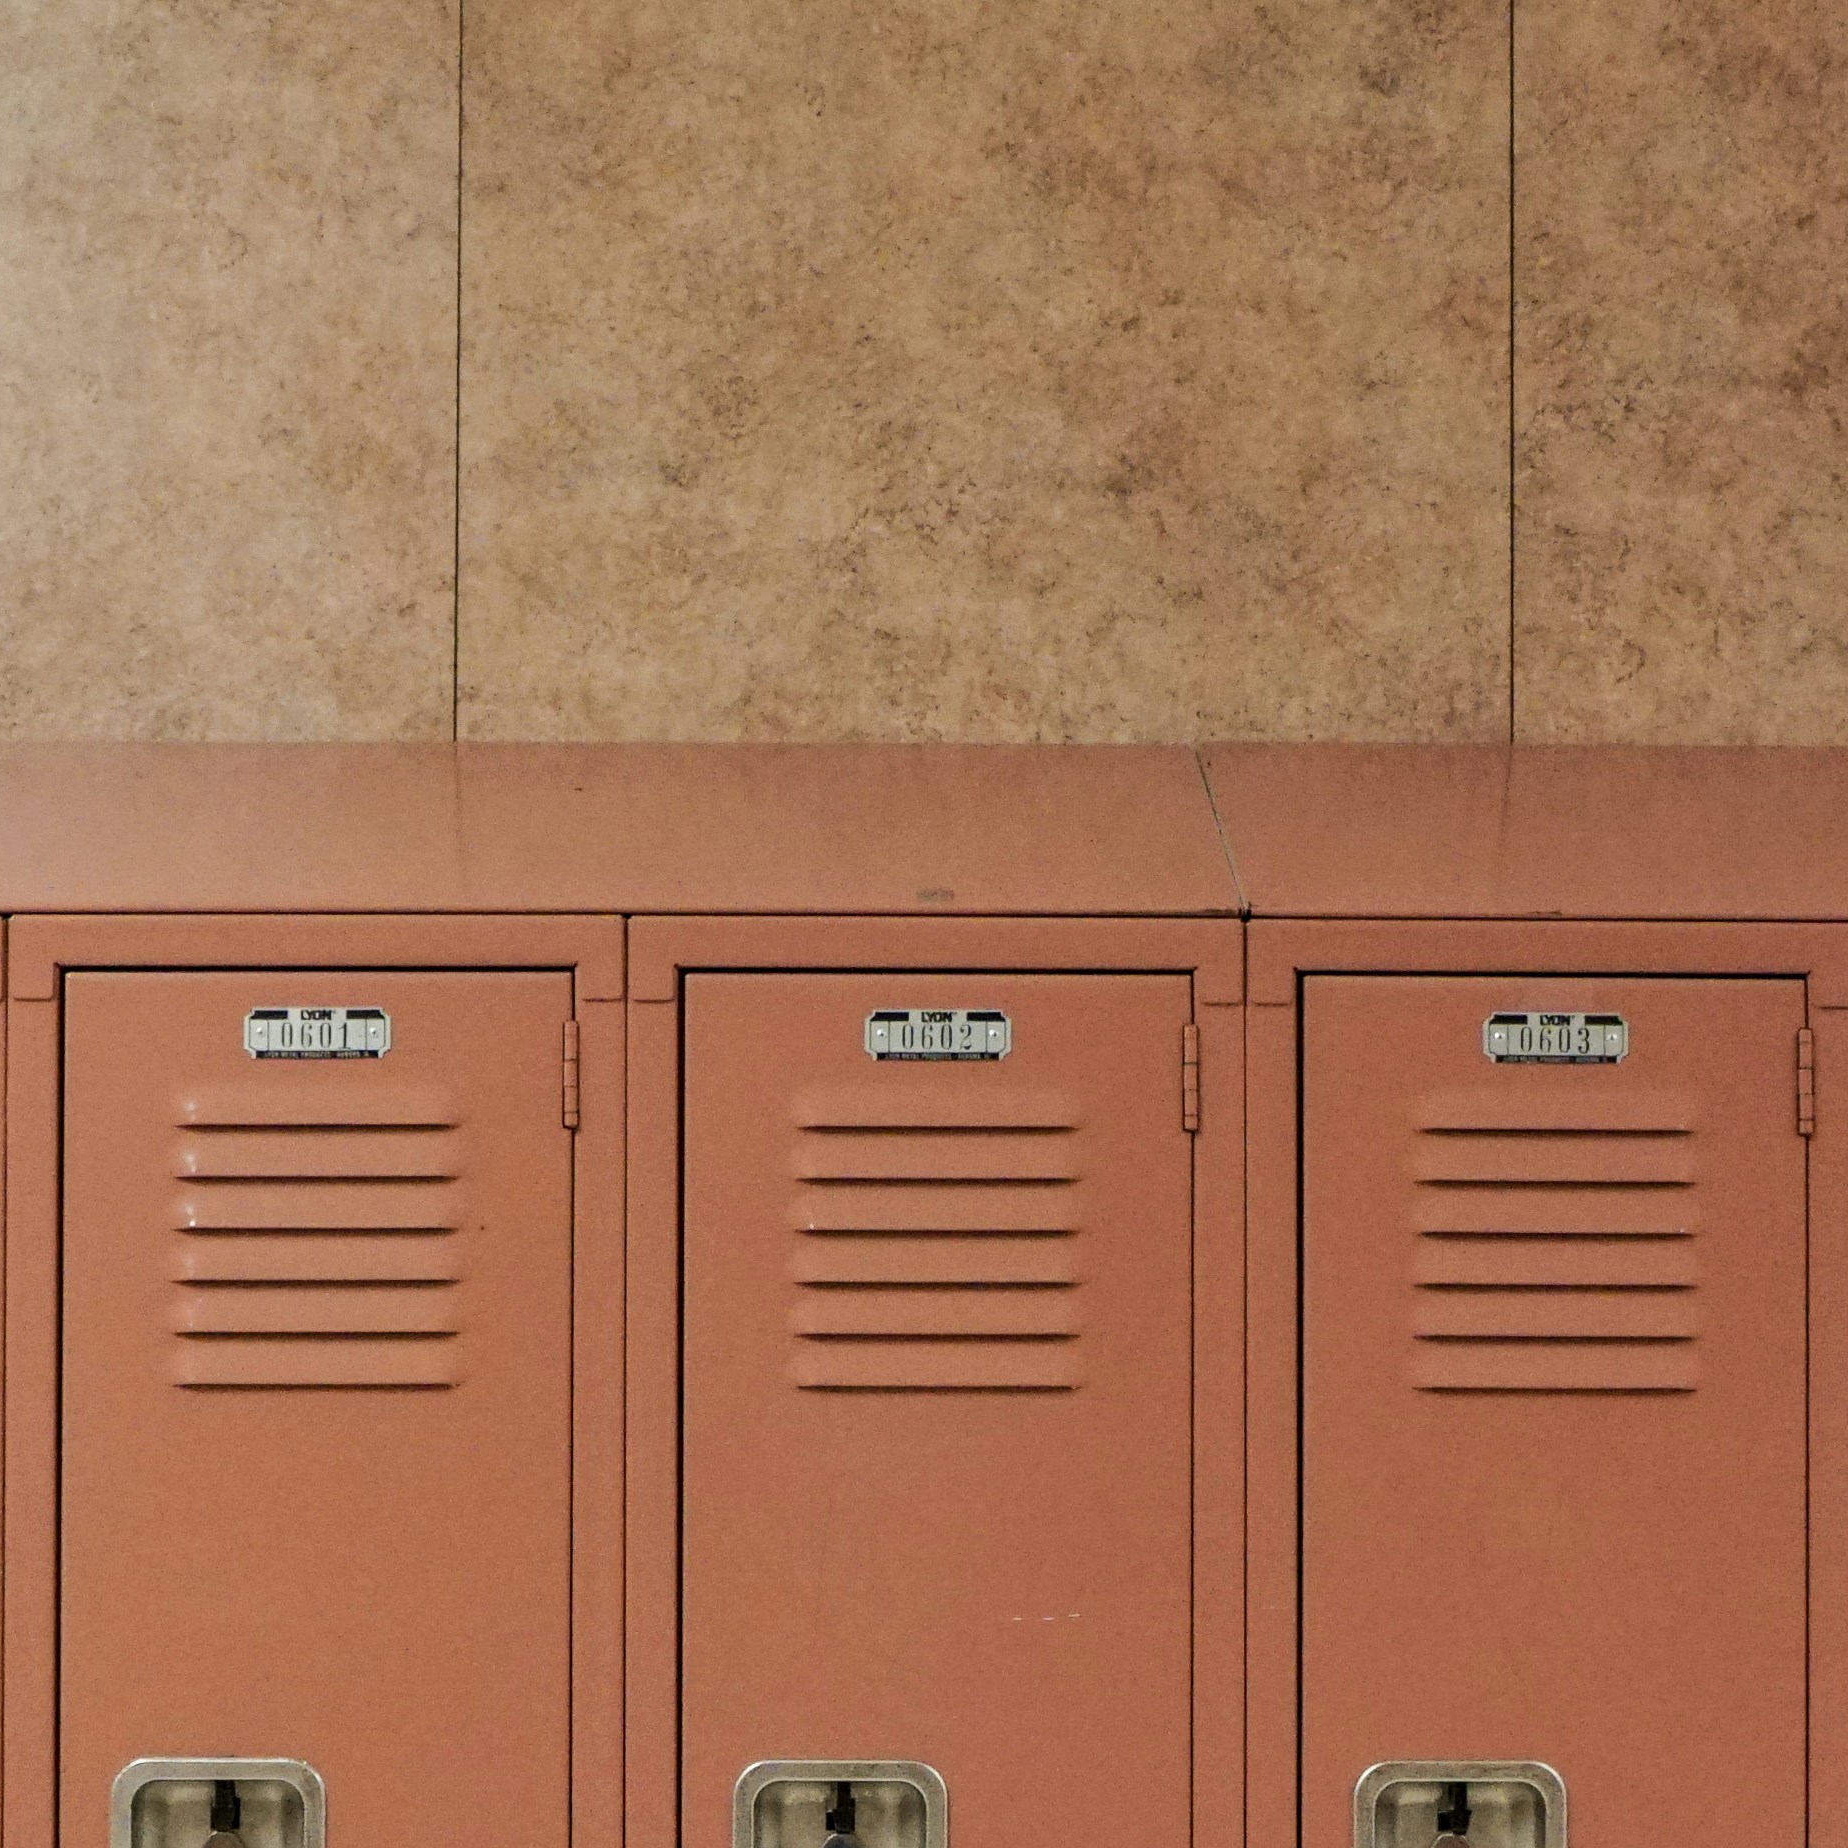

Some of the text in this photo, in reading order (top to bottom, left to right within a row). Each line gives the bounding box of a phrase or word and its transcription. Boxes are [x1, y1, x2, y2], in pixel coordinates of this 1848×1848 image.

[301, 1010, 331, 1020] LYON
[922, 1012, 952, 1022] LYON
[1540, 1015, 1570, 1025] LYON
[281, 1023, 351, 1050] 0601
[902, 1025, 972, 1050] 0602
[1520, 1027, 1589, 1053] 0603
